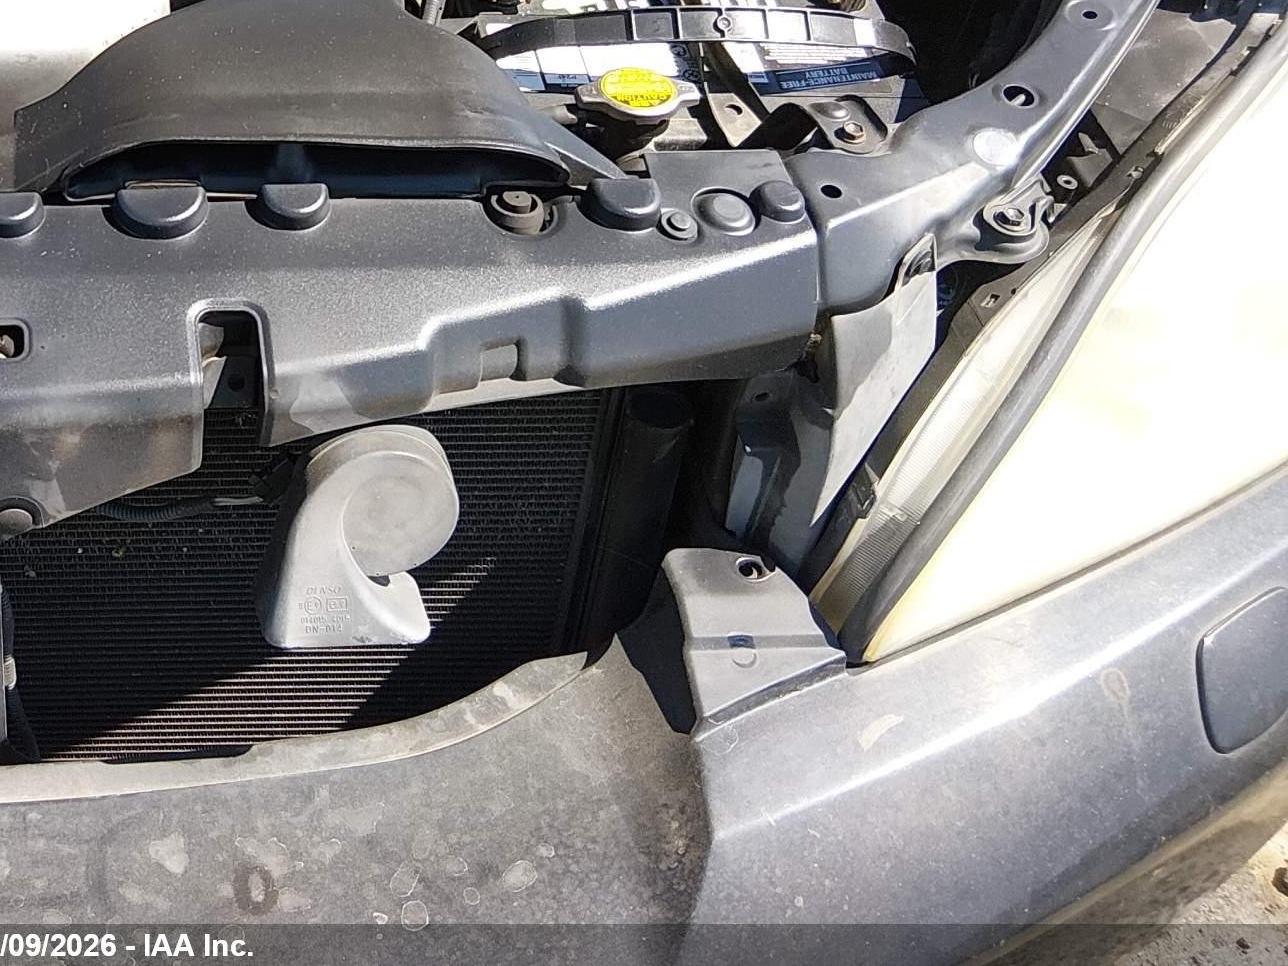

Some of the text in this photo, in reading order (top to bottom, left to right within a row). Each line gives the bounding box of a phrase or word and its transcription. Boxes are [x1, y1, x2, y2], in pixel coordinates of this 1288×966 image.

[804, 67, 848, 79] BATTERY
[780, 70, 878, 90] MAINTENANCE-FREE
[616, 93, 667, 101] CAUTION
